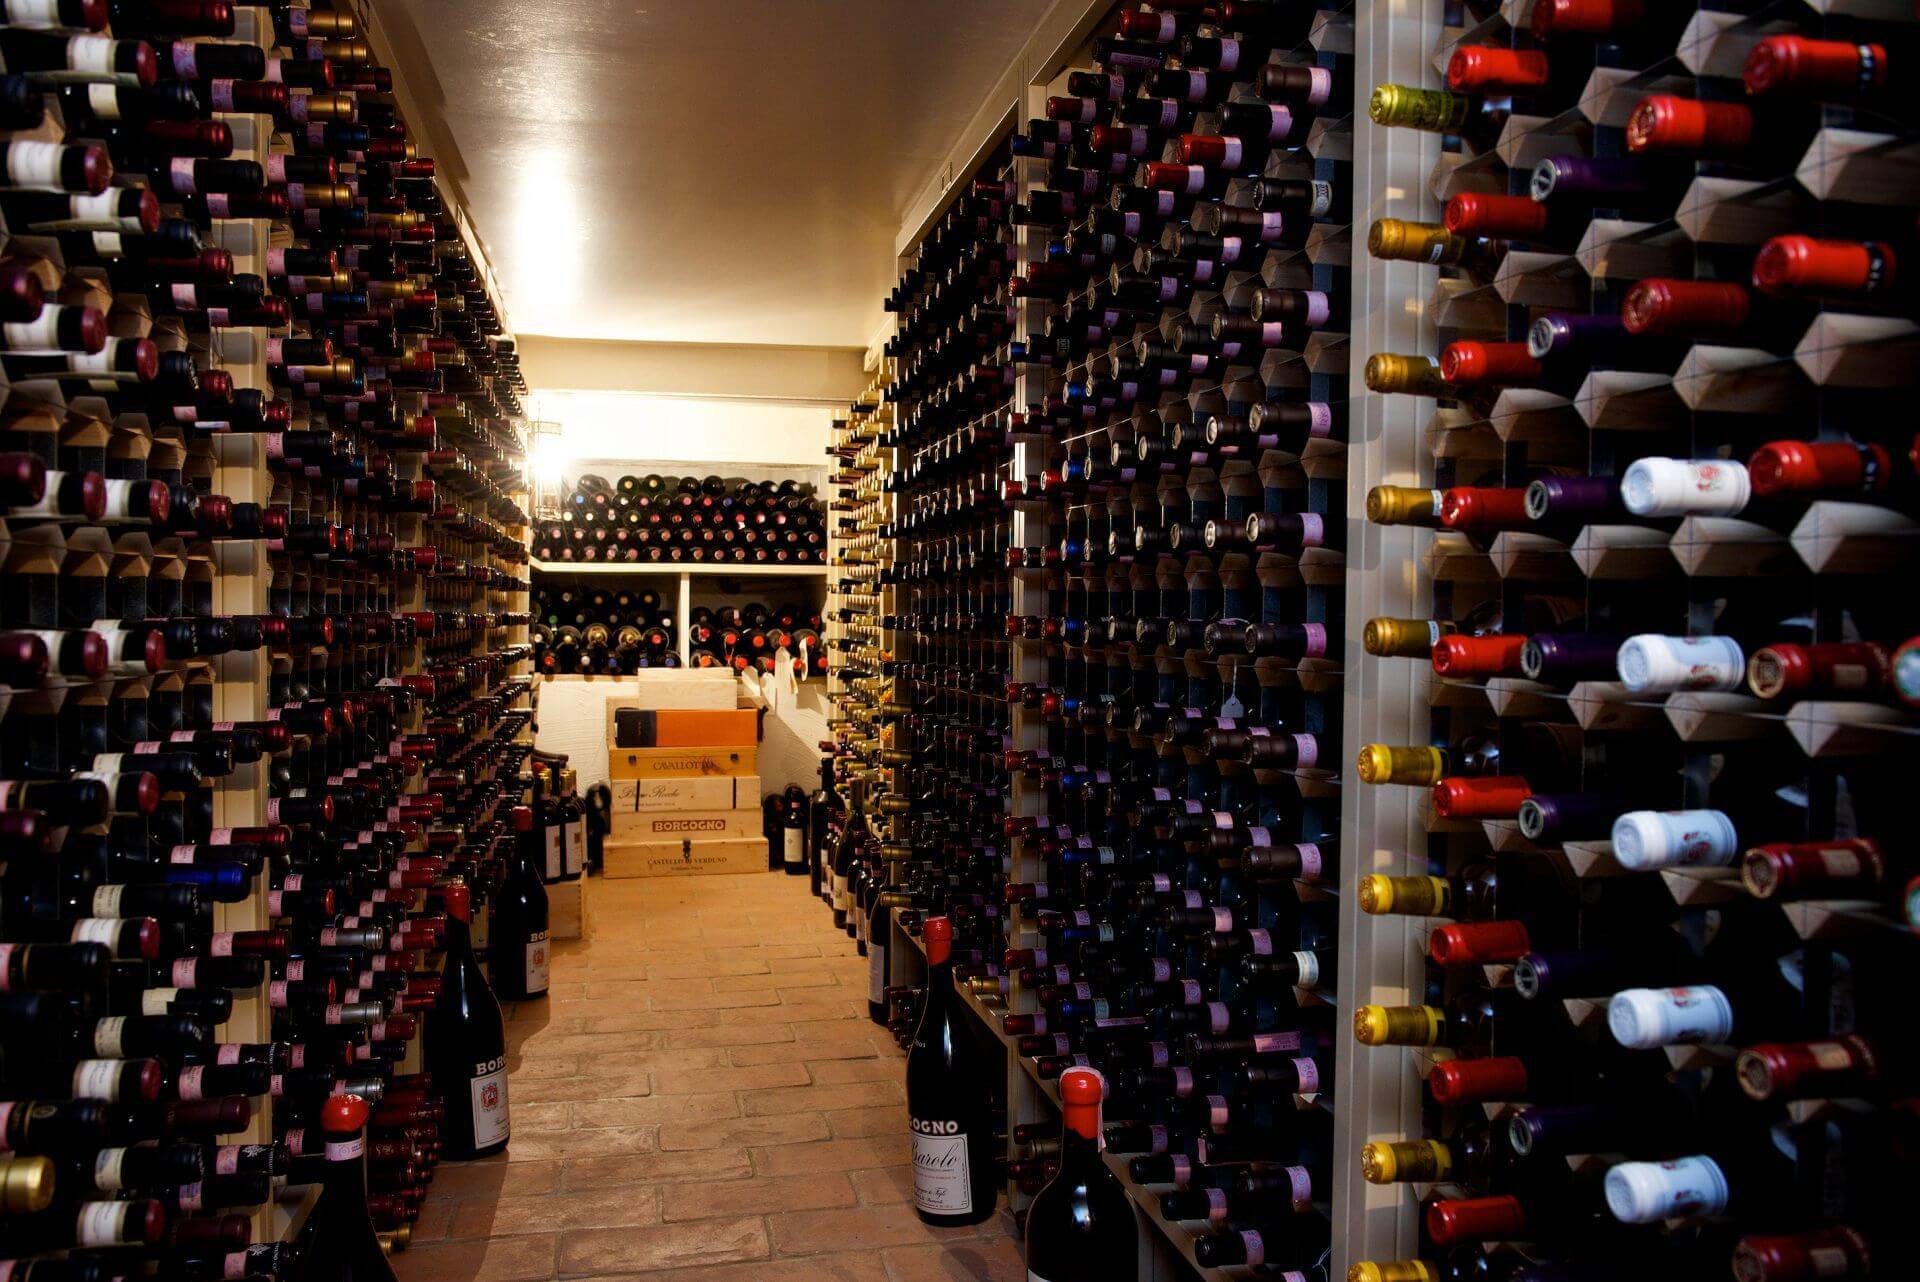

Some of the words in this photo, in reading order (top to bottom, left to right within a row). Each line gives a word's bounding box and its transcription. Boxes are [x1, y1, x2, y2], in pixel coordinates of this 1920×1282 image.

[654, 820, 724, 831] BORGOGNO
[475, 1056, 506, 1075] BOR
[909, 1117, 958, 1134] OGNO
